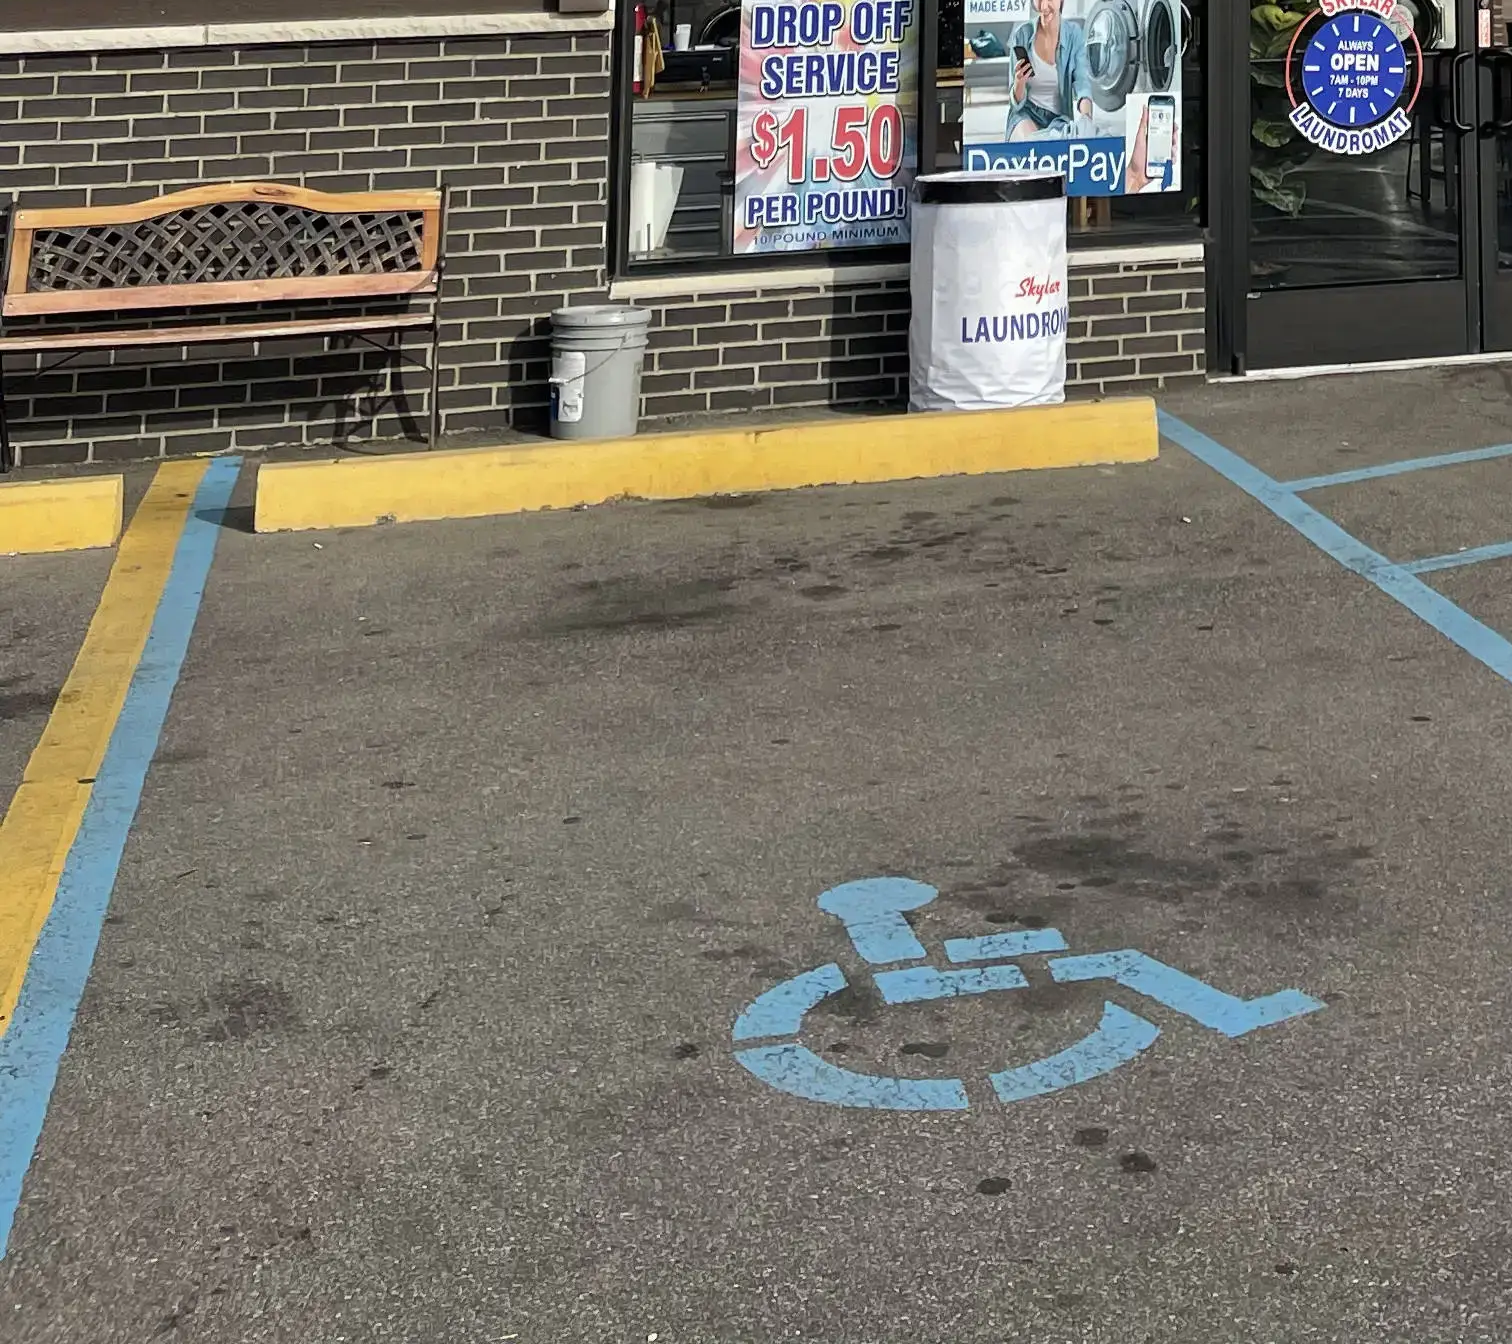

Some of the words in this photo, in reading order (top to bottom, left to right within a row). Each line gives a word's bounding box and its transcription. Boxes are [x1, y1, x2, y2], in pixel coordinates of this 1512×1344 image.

[969, 0, 997, 13] MADE
[752, 2, 844, 48] DROP
[851, 0, 913, 44] OFF
[1337, 40, 1374, 52] ALWAYS
[761, 50, 900, 99] SERVICE
[1330, 53, 1380, 72] OPEN
[1330, 74, 1349, 86] 7AM
[1356, 75, 1379, 86] 10PM
[1338, 87, 1344, 98] 7
[1345, 87, 1369, 99] DAYS
[1290, 103, 1410, 153] LAUNDROMAT
[751, 104, 905, 183] $1.50
[745, 194, 799, 229] PER
[805, 187, 906, 224] POUND!
[754, 235, 768, 246] 10
[773, 231, 827, 244] POUND
[832, 226, 899, 240] MINIMUM
[1015, 274, 1061, 304] Skylar
